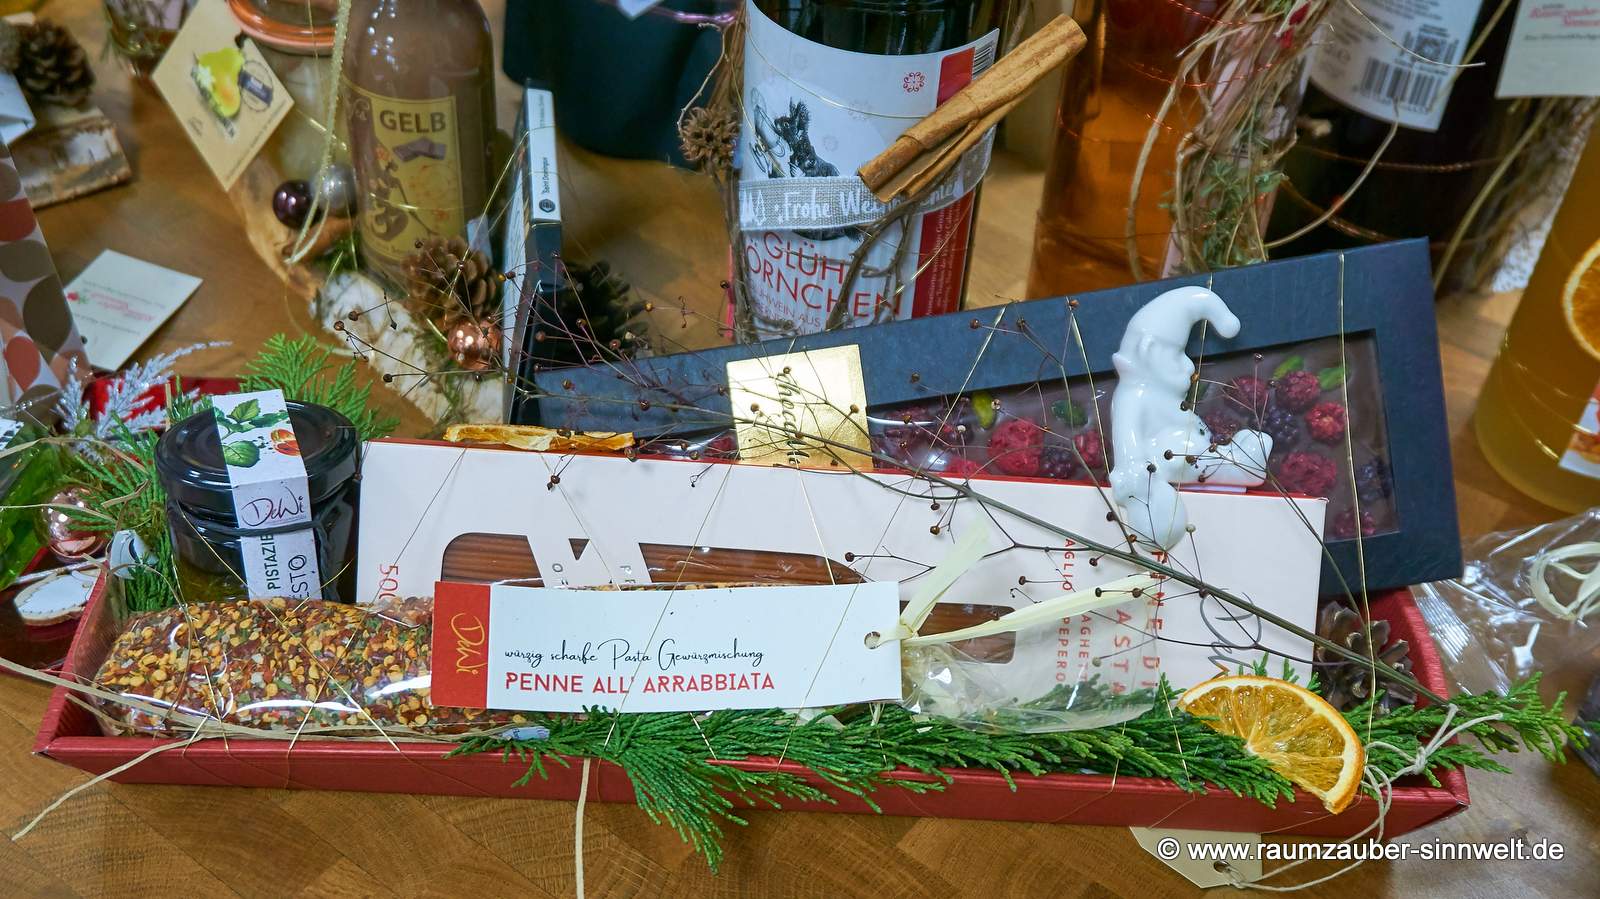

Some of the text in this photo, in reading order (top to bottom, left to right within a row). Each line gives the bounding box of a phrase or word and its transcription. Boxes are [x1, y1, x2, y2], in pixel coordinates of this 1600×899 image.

[380, 110, 447, 133] GELB
[784, 188, 833, 221] Frohe
[744, 239, 903, 324] ÖRNCHEN
[763, 231, 846, 285] GLÜH
[241, 486, 304, 527] DeWi
[1055, 538, 1076, 682] AGLIO PEPERO
[451, 612, 486, 675] DeWi
[505, 638, 764, 670] würzig scharfe Pasta Gewürzmischung
[1111, 608, 1132, 694] ASTA
[506, 672, 584, 693] PENNE
[643, 672, 775, 693] ARRABBIATA
